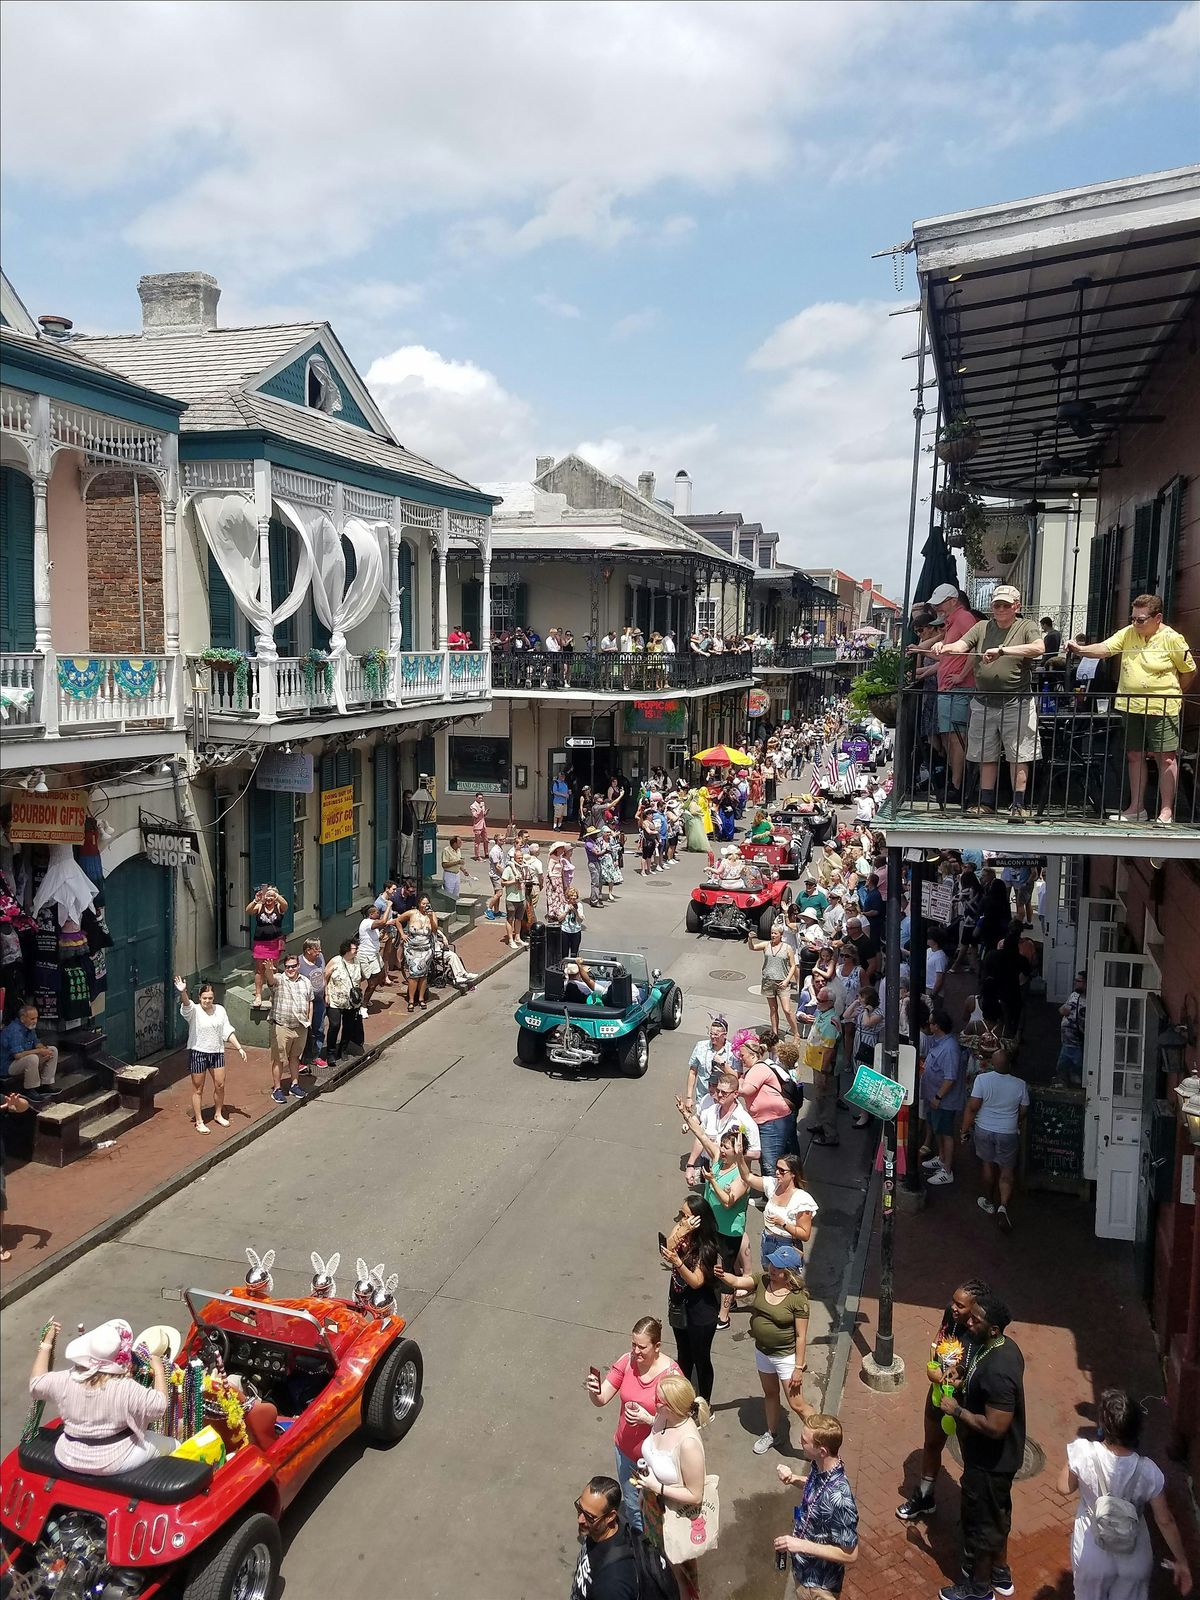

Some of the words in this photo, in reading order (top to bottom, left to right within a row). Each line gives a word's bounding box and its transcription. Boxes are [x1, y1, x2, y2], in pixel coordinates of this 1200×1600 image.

[71, 792, 80, 800] ST
[13, 803, 57, 825] BOURBON
[60, 806, 85, 826] GIFTS
[326, 811, 343, 826] MUST
[344, 809, 352, 820] GO
[11, 830, 33, 839] LOWEST
[34, 831, 50, 840] PRICE
[50, 832, 85, 841] GUARANTEED
[147, 833, 191, 853] SMOKE
[151, 850, 187, 867] SHOP
[857, 1071, 868, 1092] BOTTLES
